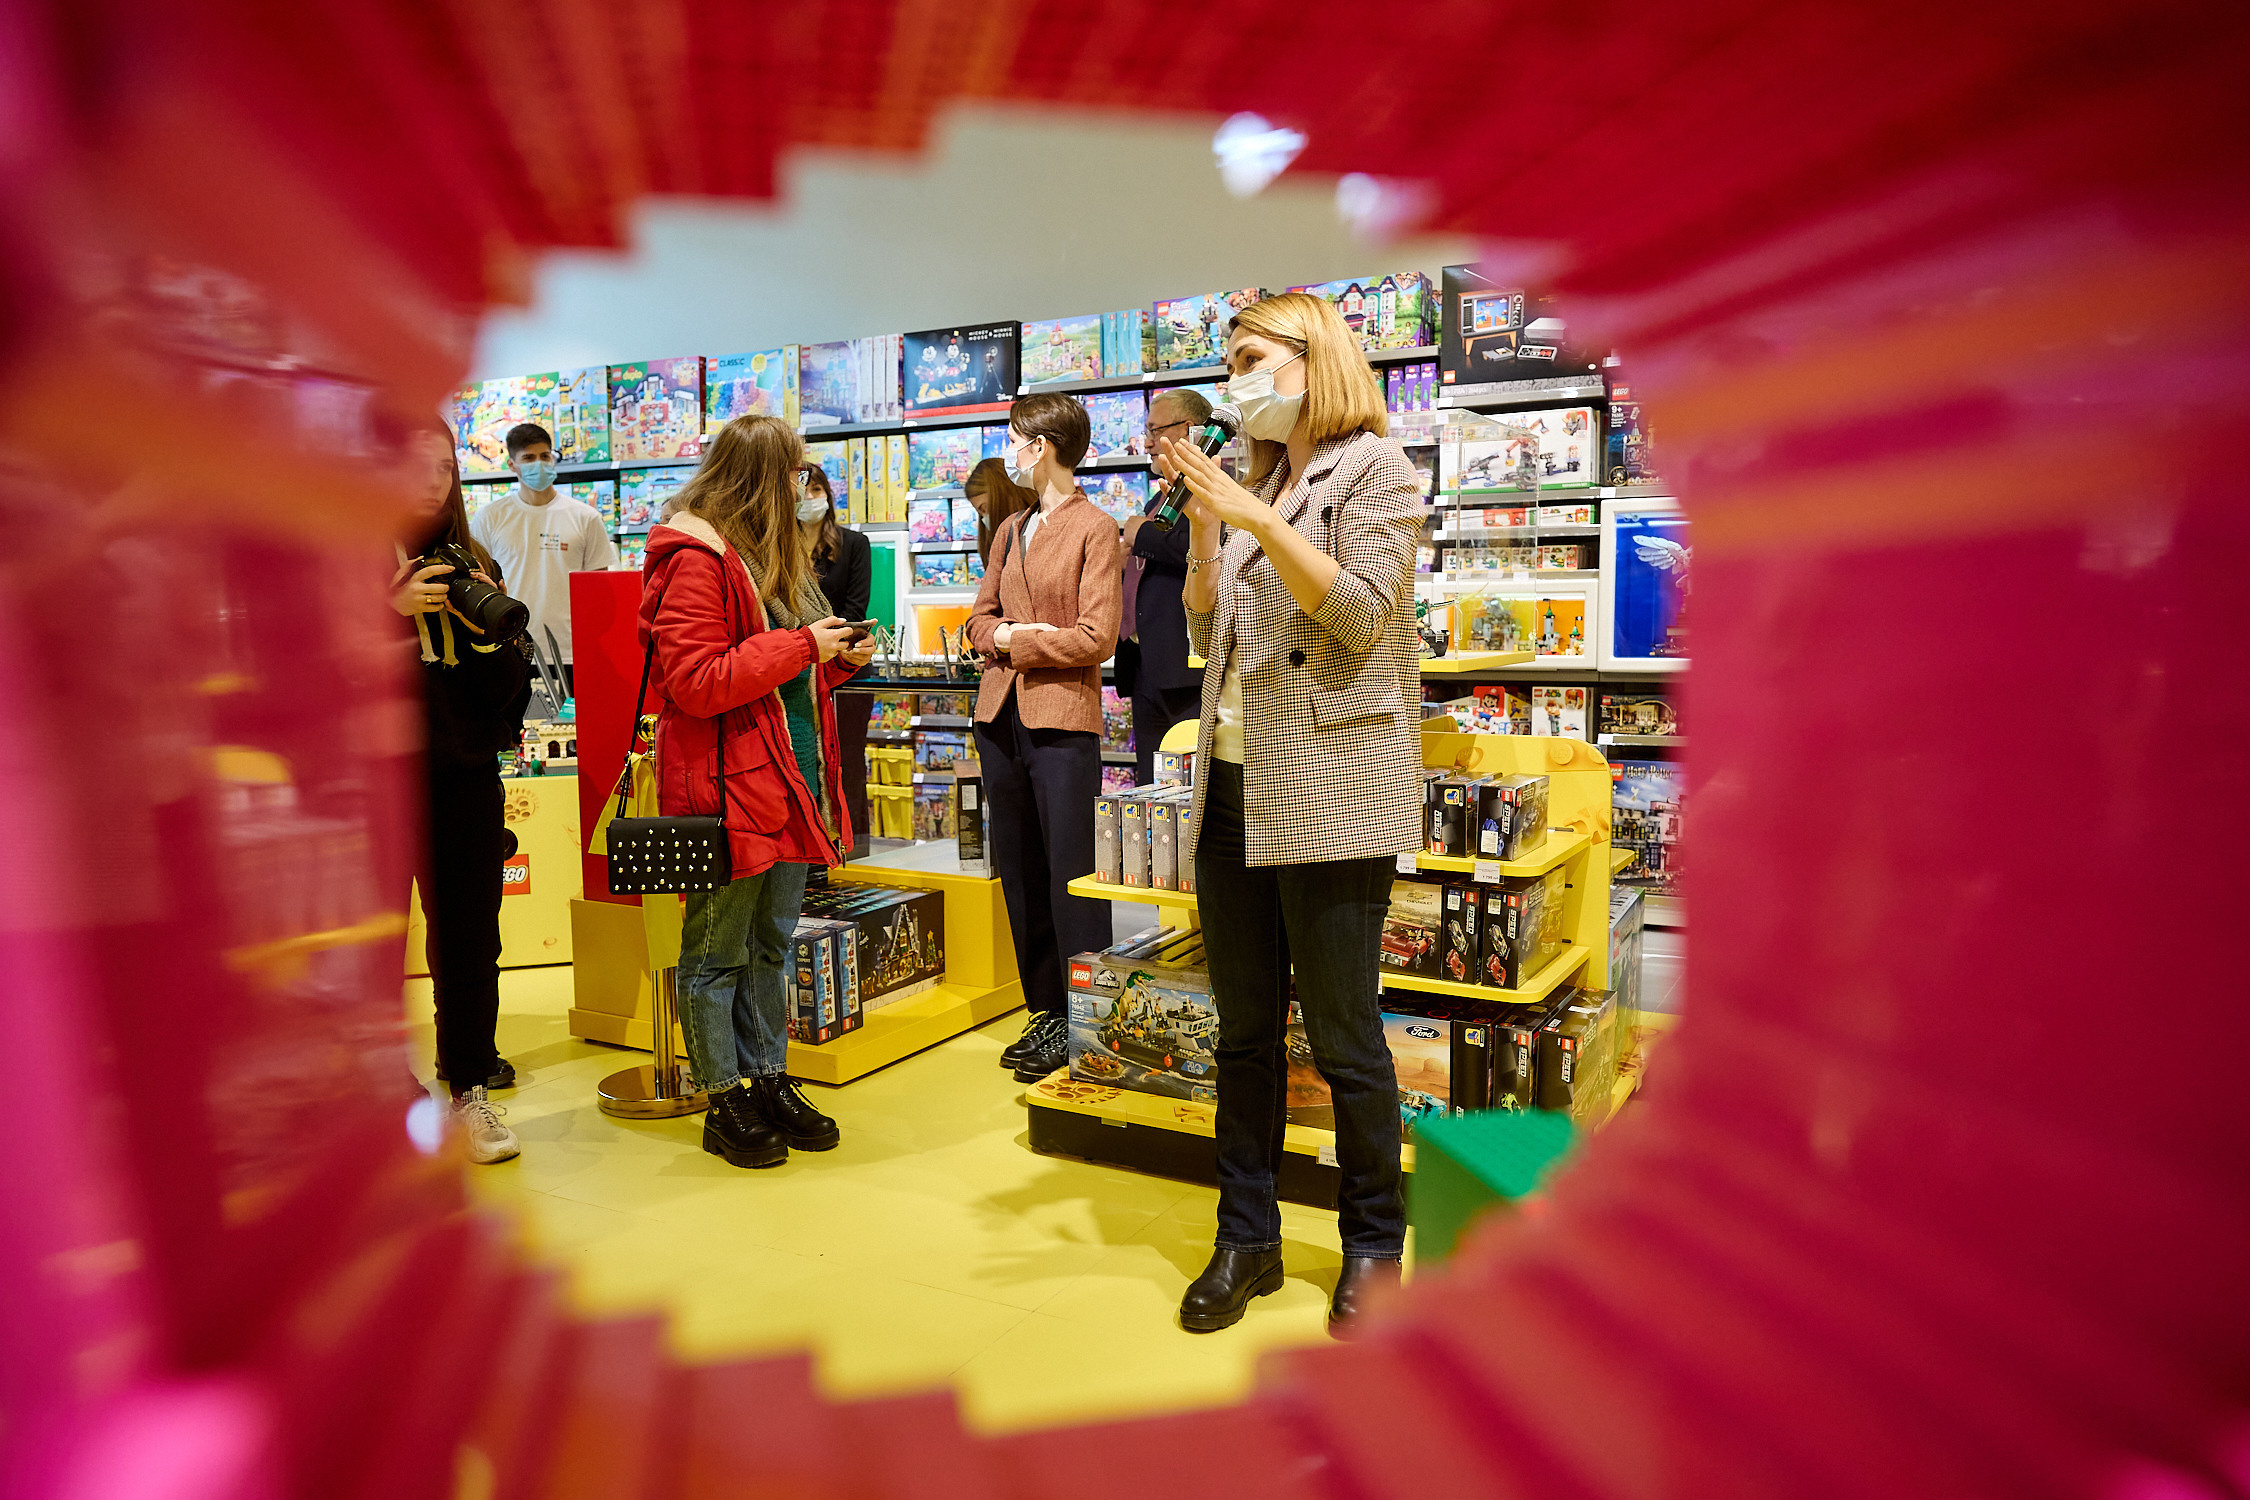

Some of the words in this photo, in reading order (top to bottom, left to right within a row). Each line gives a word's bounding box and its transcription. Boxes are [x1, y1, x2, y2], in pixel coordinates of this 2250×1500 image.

[1613, 387, 1630, 396] LEGO
[1504, 804, 1512, 835] SPEED
[1468, 904, 1476, 935] SPEED
[1073, 970, 1091, 982] LEGO
[1072, 994, 1083, 1003] 8+
[1411, 1026, 1435, 1038] Ford
[1519, 1047, 1528, 1078] SPEED
[1563, 1052, 1572, 1083] SPEED
